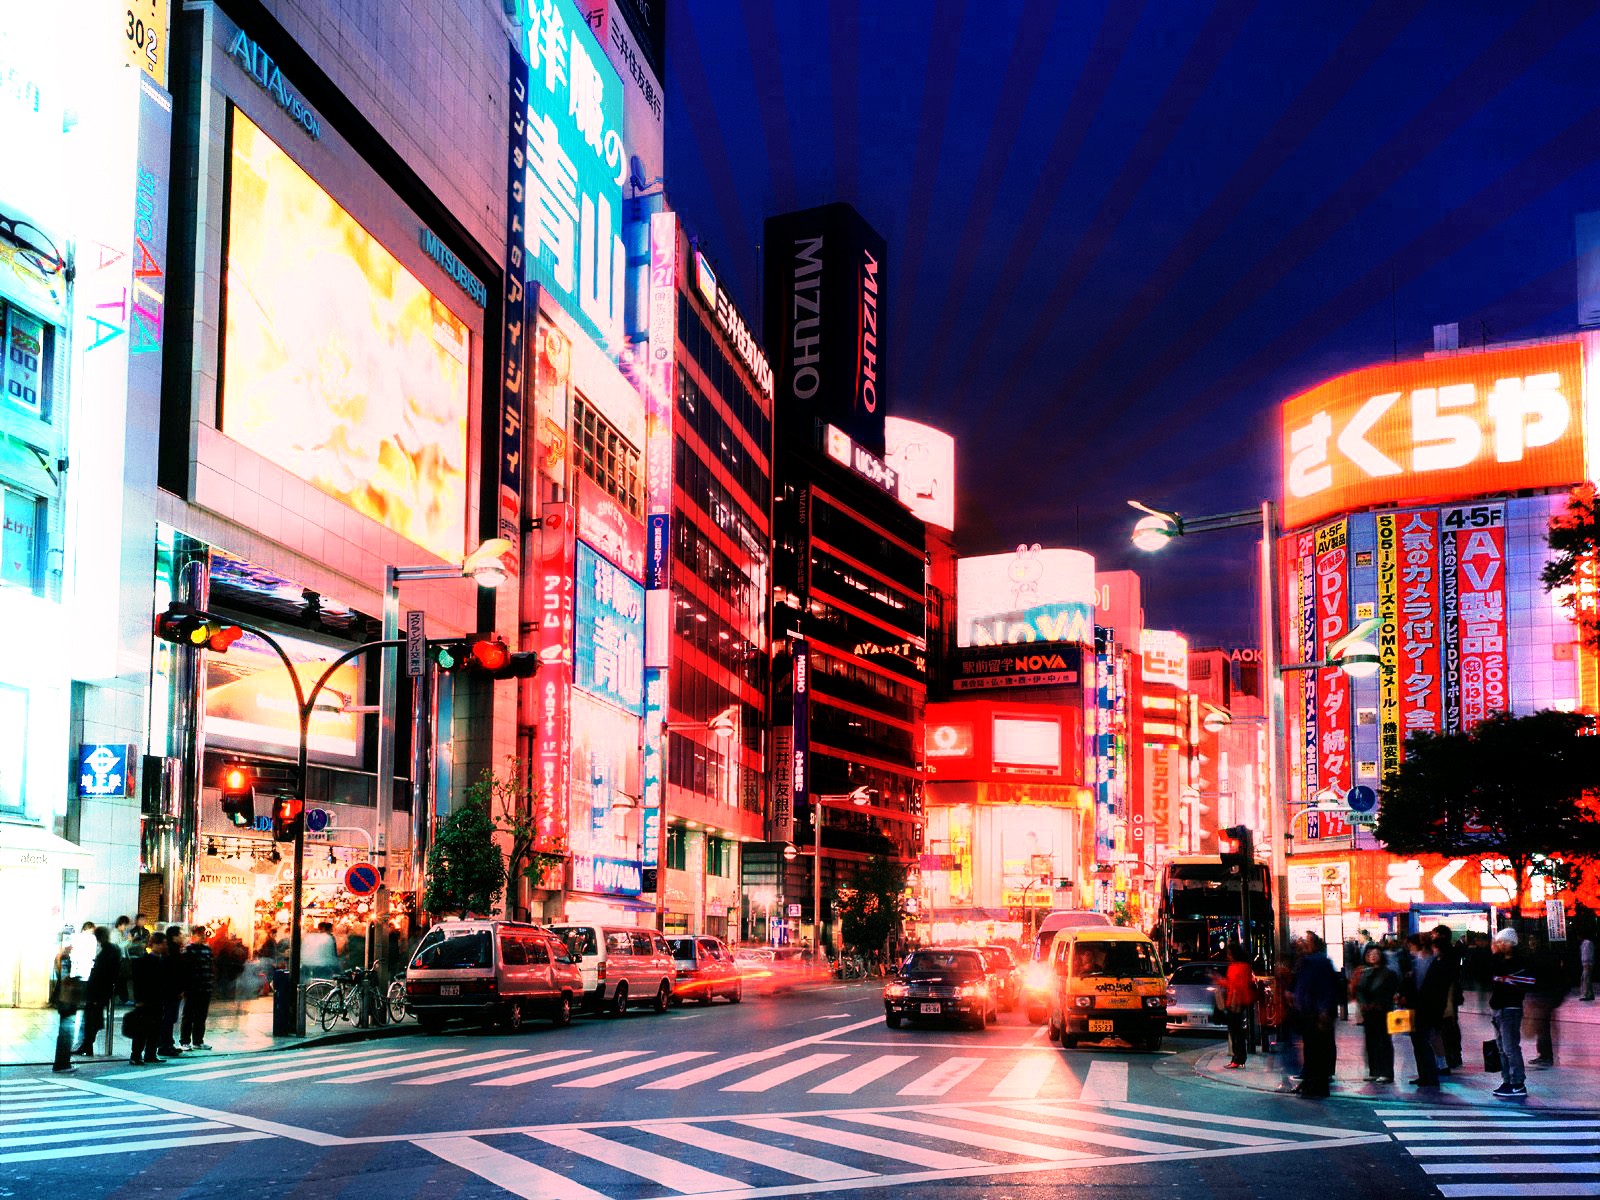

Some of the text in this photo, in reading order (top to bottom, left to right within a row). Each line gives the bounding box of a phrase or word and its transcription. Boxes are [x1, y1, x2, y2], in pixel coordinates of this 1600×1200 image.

[611, 16, 662, 122] 三井住友銀行
[424, 229, 487, 308] MITSUBISHI
[526, 104, 626, 347] 青山
[84, 239, 127, 352] ATA
[792, 234, 824, 400] MIZUHO
[862, 248, 879, 414] MIZUHO
[1288, 371, 1571, 498] さくらや
[974, 609, 1090, 648] NOVA
[1402, 513, 1437, 738] 人気のカメラ付ケータイ全
[1460, 530, 1504, 654] AV製品
[797, 654, 806, 693] MIZUHO
[962, 653, 1068, 675] 駅前留学 NOVA
[774, 736, 790, 828] 三井住友銀行
[199, 874, 221, 884] ATIN
[1326, 868, 1336, 880] 2
